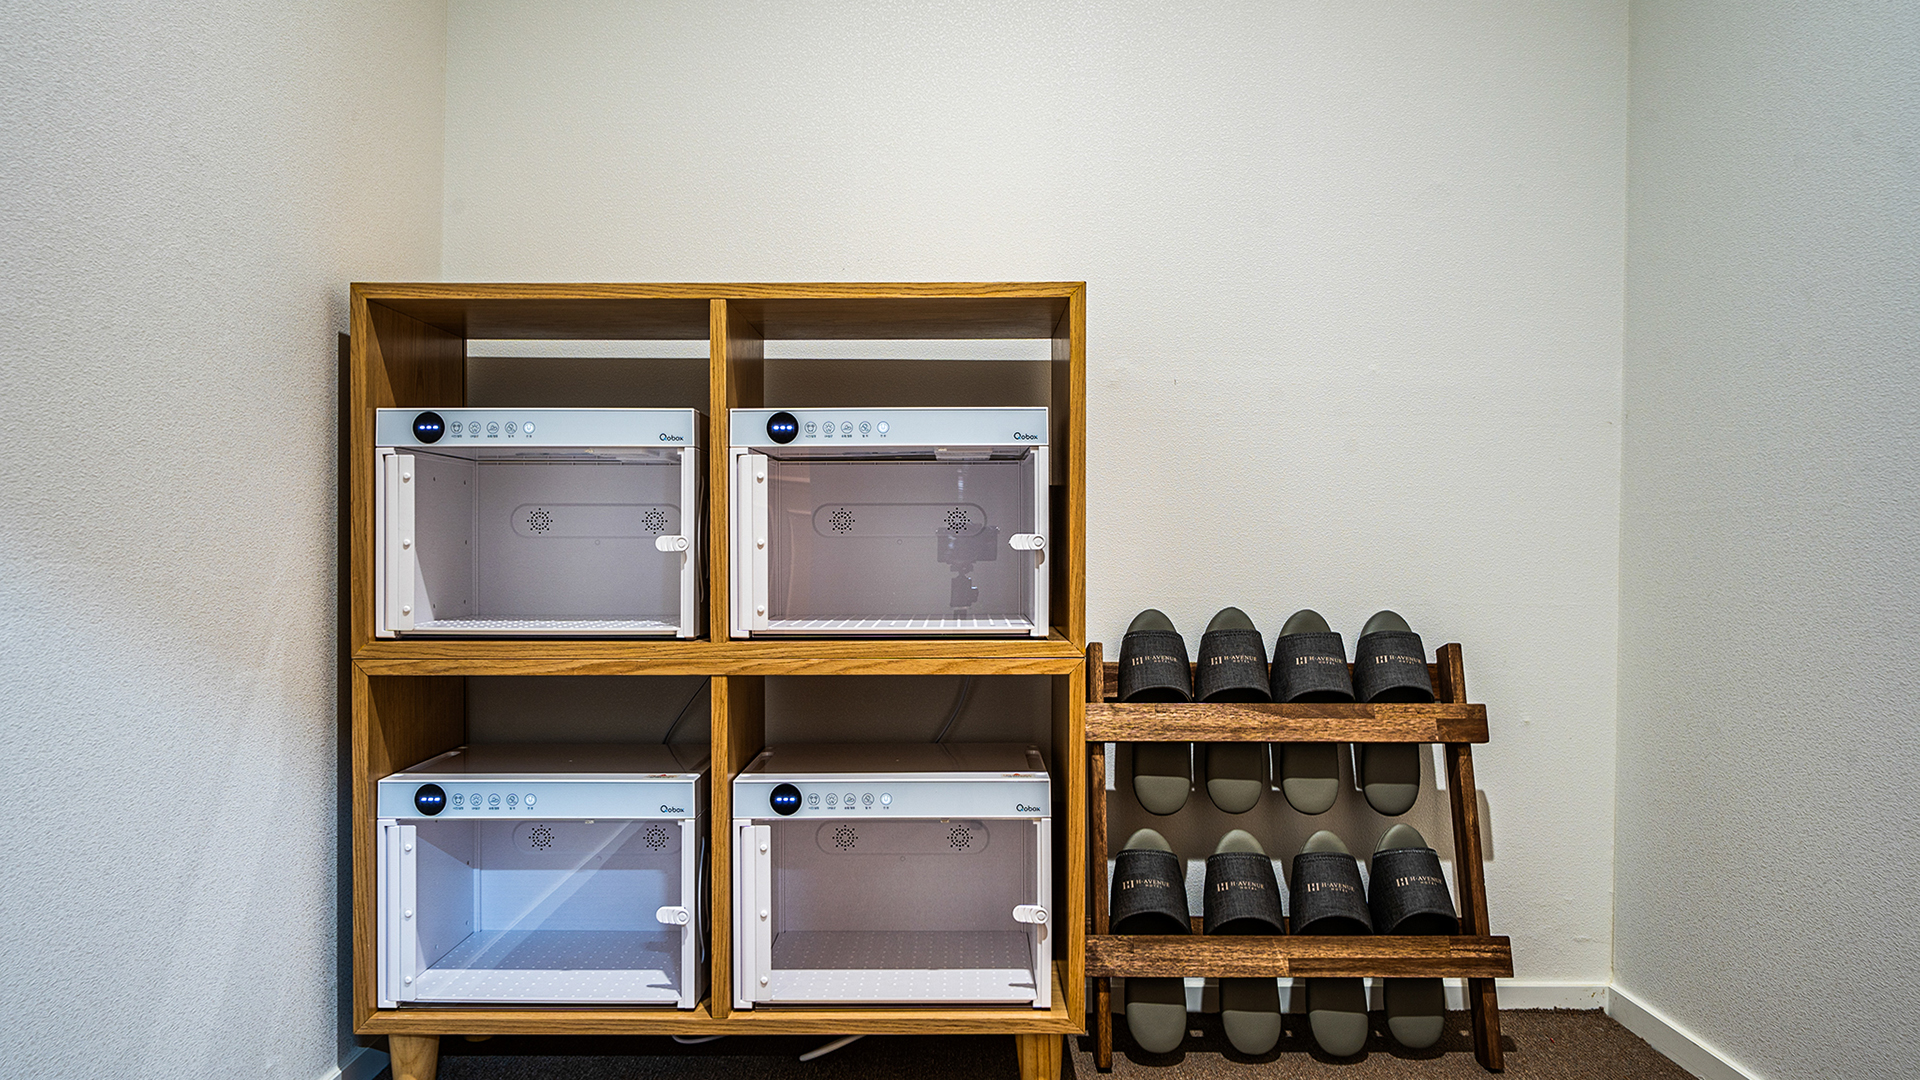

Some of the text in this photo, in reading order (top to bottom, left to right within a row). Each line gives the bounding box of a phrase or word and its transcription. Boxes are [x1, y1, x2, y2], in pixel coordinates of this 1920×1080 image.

[659, 432, 684, 442] Qobox
[1013, 432, 1038, 440] Qobox
[660, 804, 684, 813] Qobox
[1016, 804, 1040, 812] Qobox
